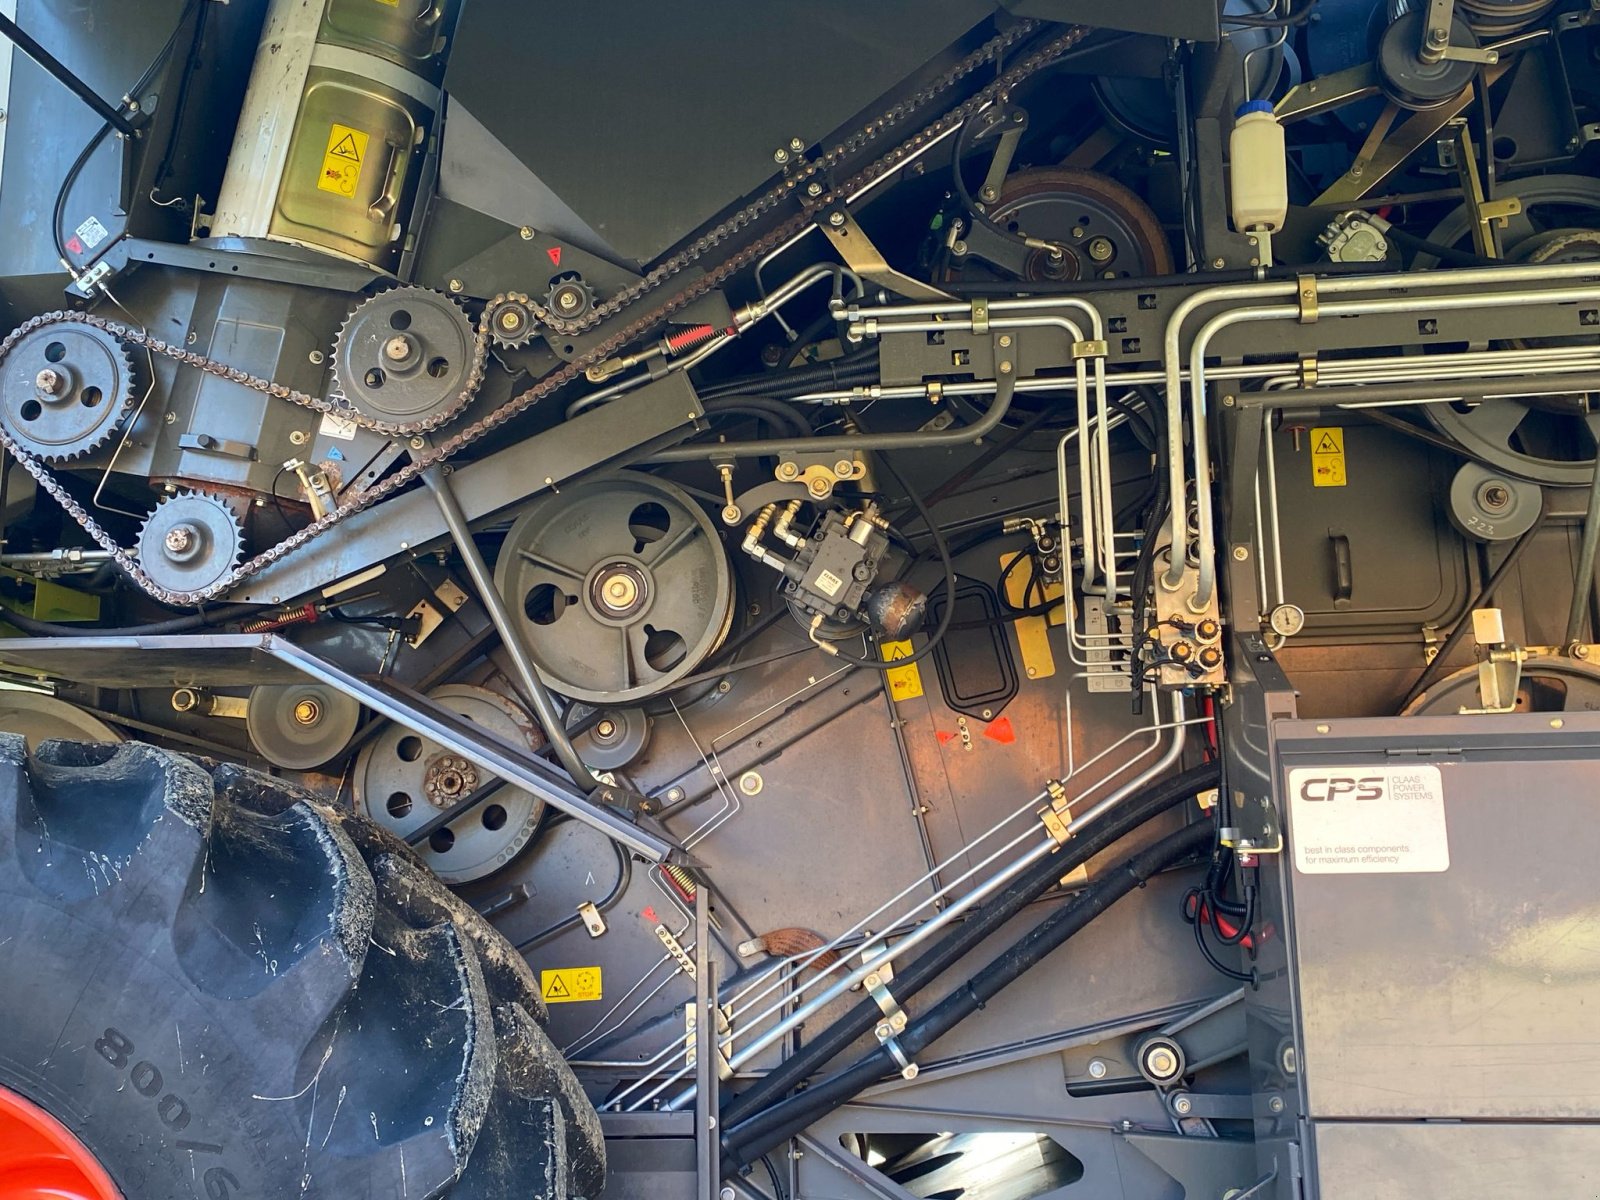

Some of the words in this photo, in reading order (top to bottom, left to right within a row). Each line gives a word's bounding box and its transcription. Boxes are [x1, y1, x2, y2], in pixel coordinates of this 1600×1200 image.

[1467, 516, 1494, 535] 723
[1392, 775, 1420, 784] CLAAS
[1300, 777, 1384, 801] CPS
[1393, 784, 1425, 792] POWER
[1393, 792, 1433, 800] SYSTEMS
[1304, 845, 1323, 854] best
[1325, 846, 1333, 854] in
[1334, 845, 1356, 854] class
[1357, 845, 1410, 854] components
[1305, 856, 1317, 864] for
[1319, 856, 1359, 864] maximum
[1361, 854, 1400, 865] efficiency
